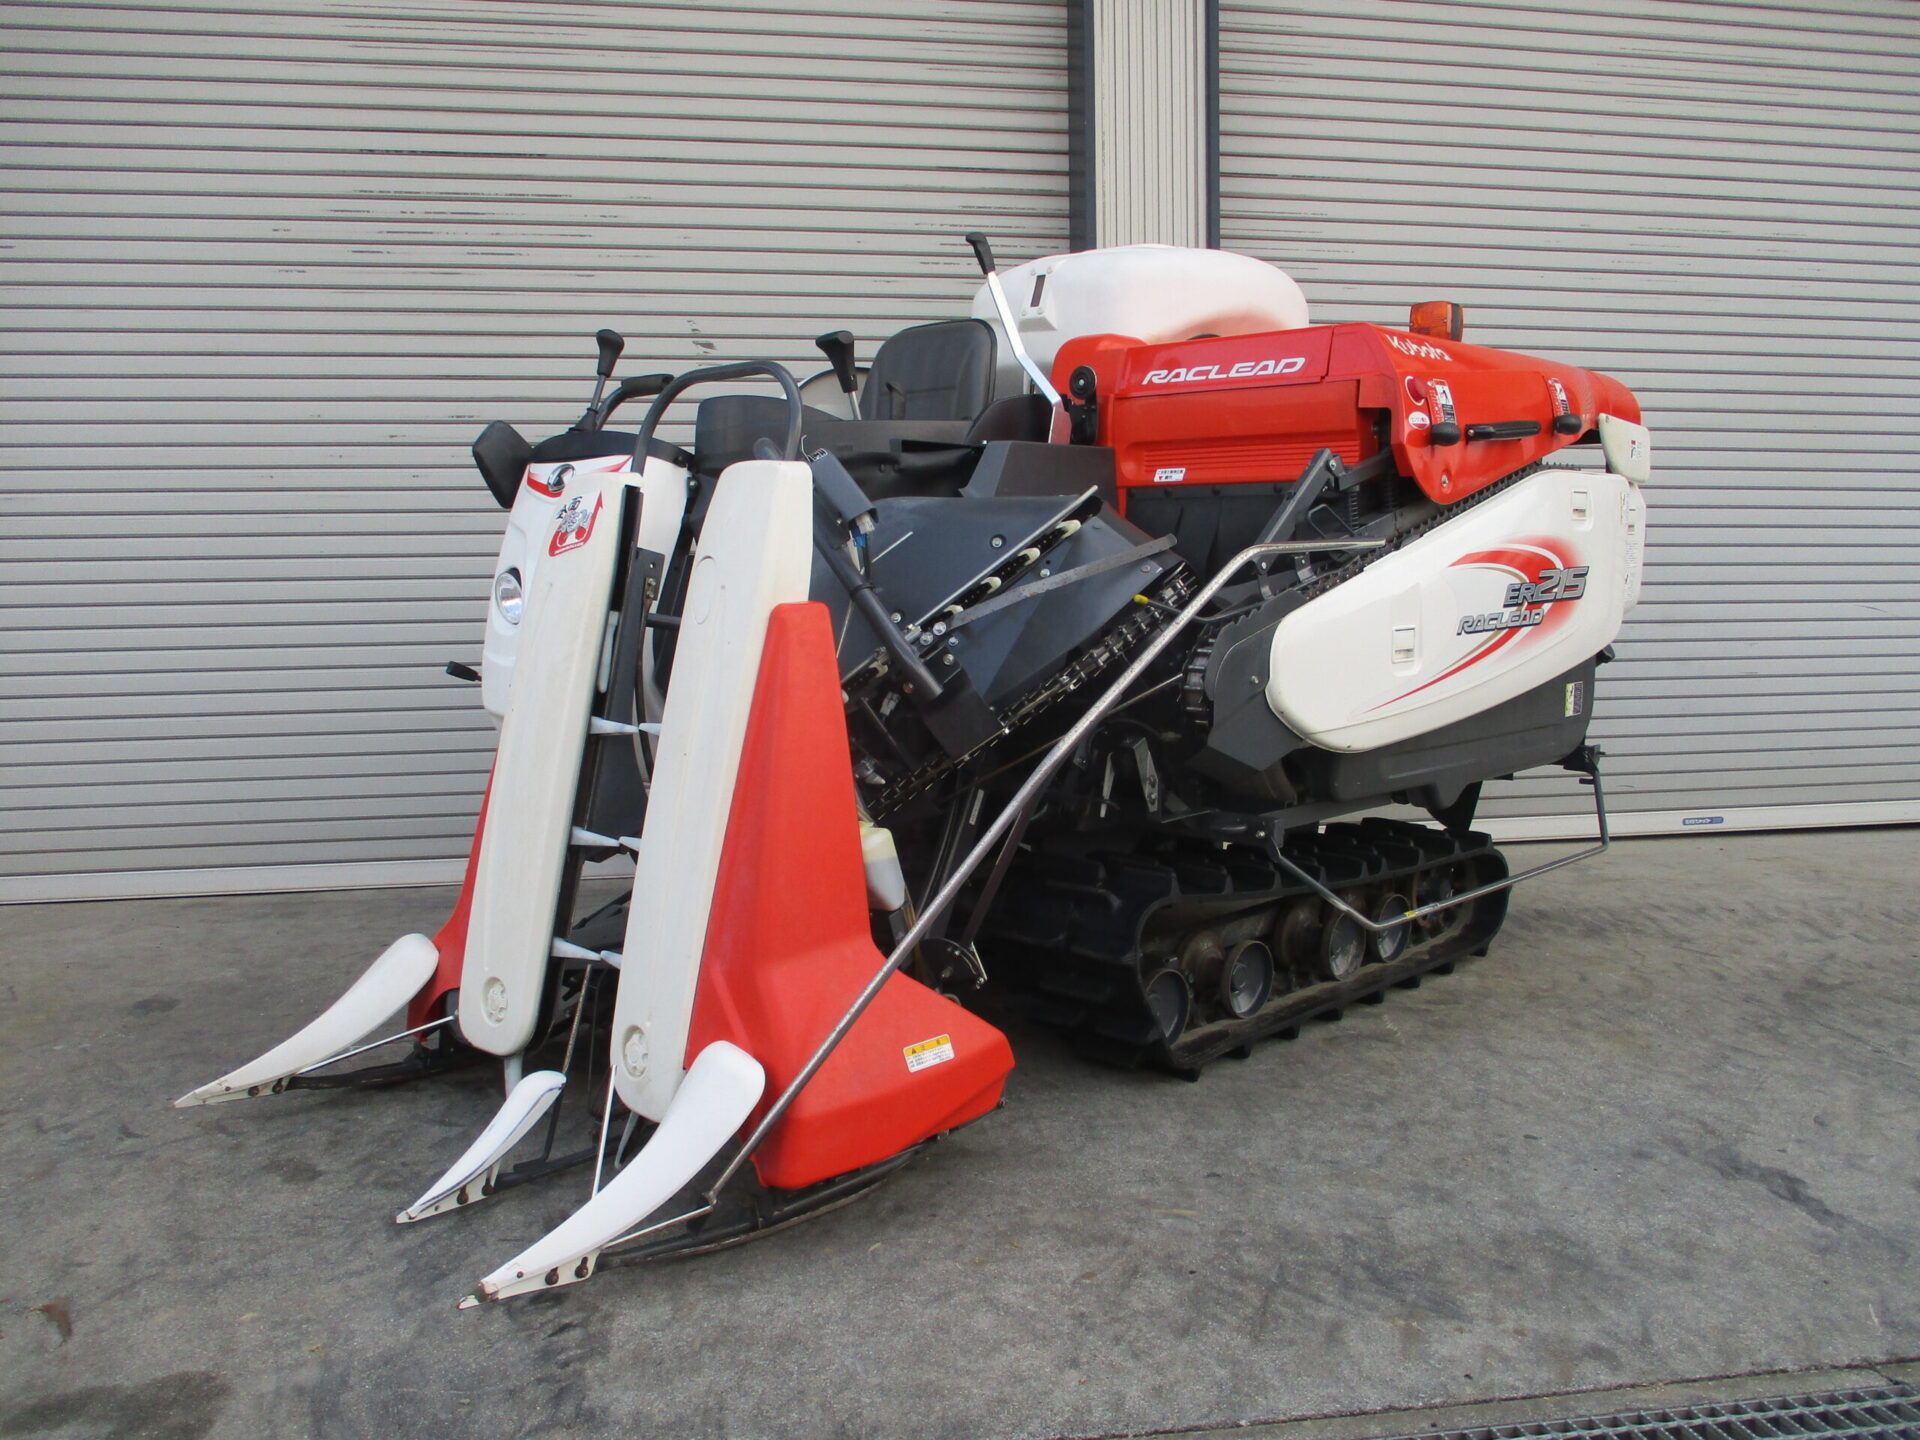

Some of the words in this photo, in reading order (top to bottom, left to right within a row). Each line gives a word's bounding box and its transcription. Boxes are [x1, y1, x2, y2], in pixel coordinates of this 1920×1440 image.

[1385, 334, 1452, 360] Kubota
[1141, 357, 1306, 385] RACLEAD
[1503, 565, 1590, 608] ER215
[1456, 608, 1544, 635] RACLEAD
